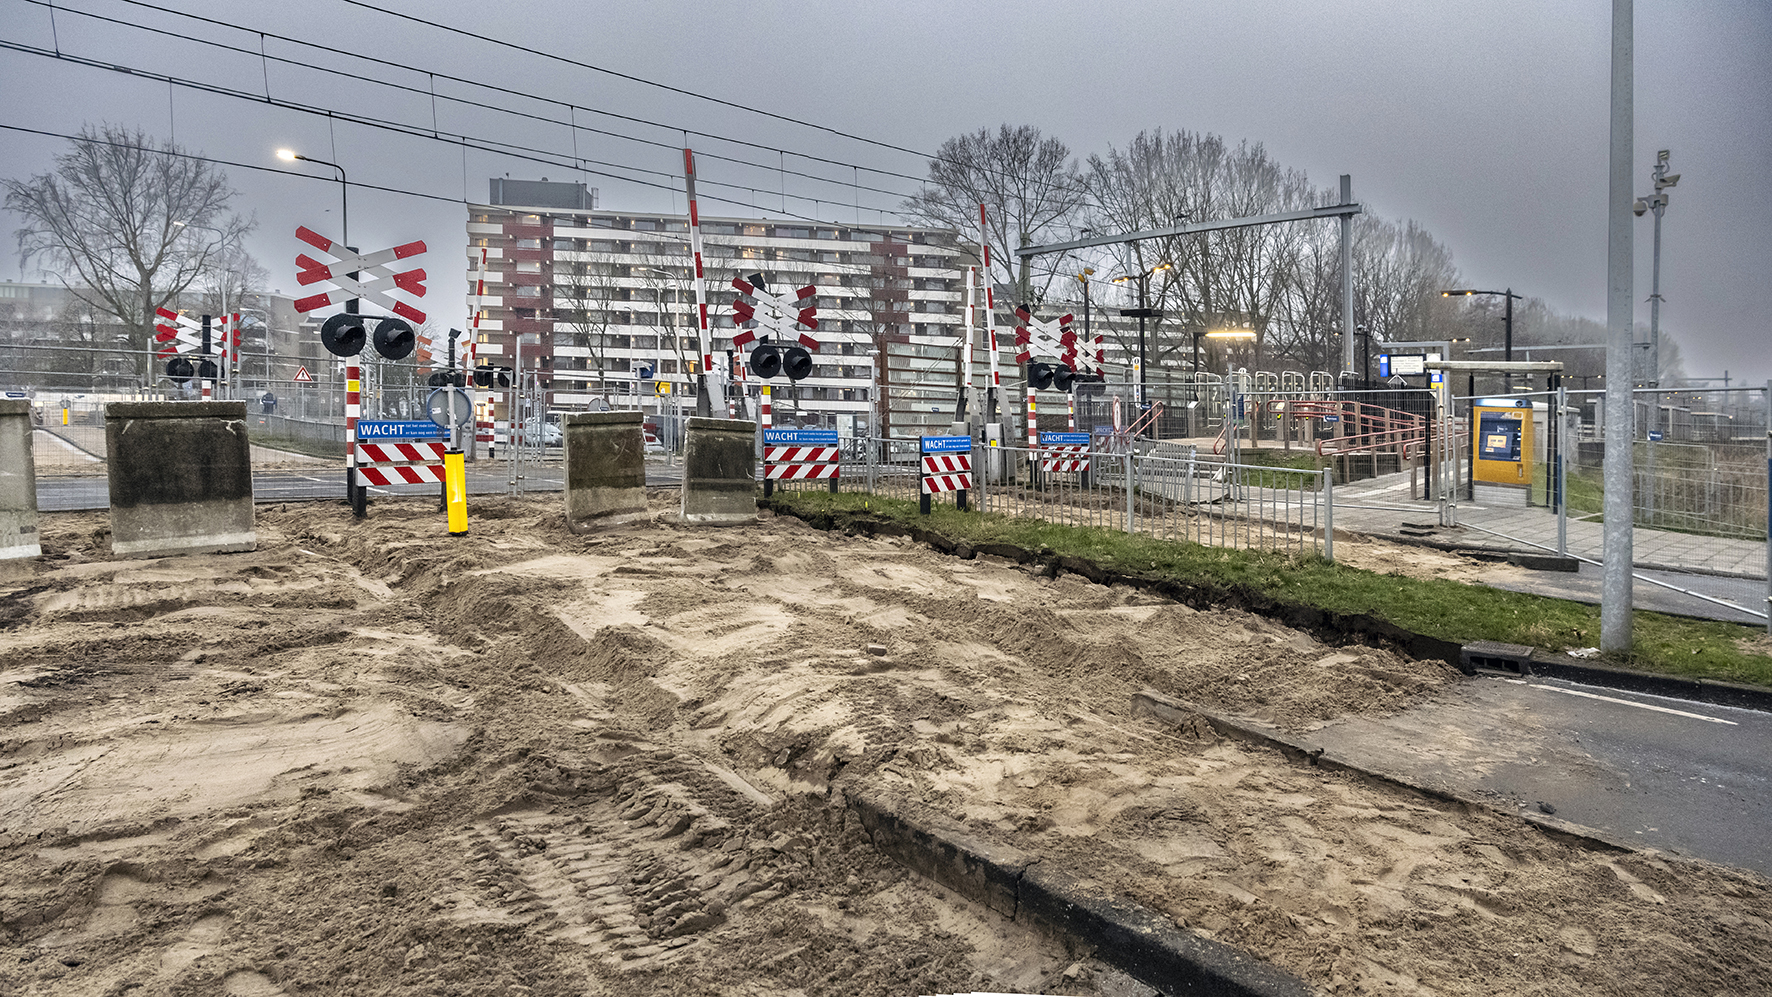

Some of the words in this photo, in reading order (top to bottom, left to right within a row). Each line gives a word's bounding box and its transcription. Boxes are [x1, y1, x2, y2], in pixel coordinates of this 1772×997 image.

[360, 424, 404, 435] WACHT
[765, 432, 798, 441] WACHT
[924, 440, 946, 449] WACHT
